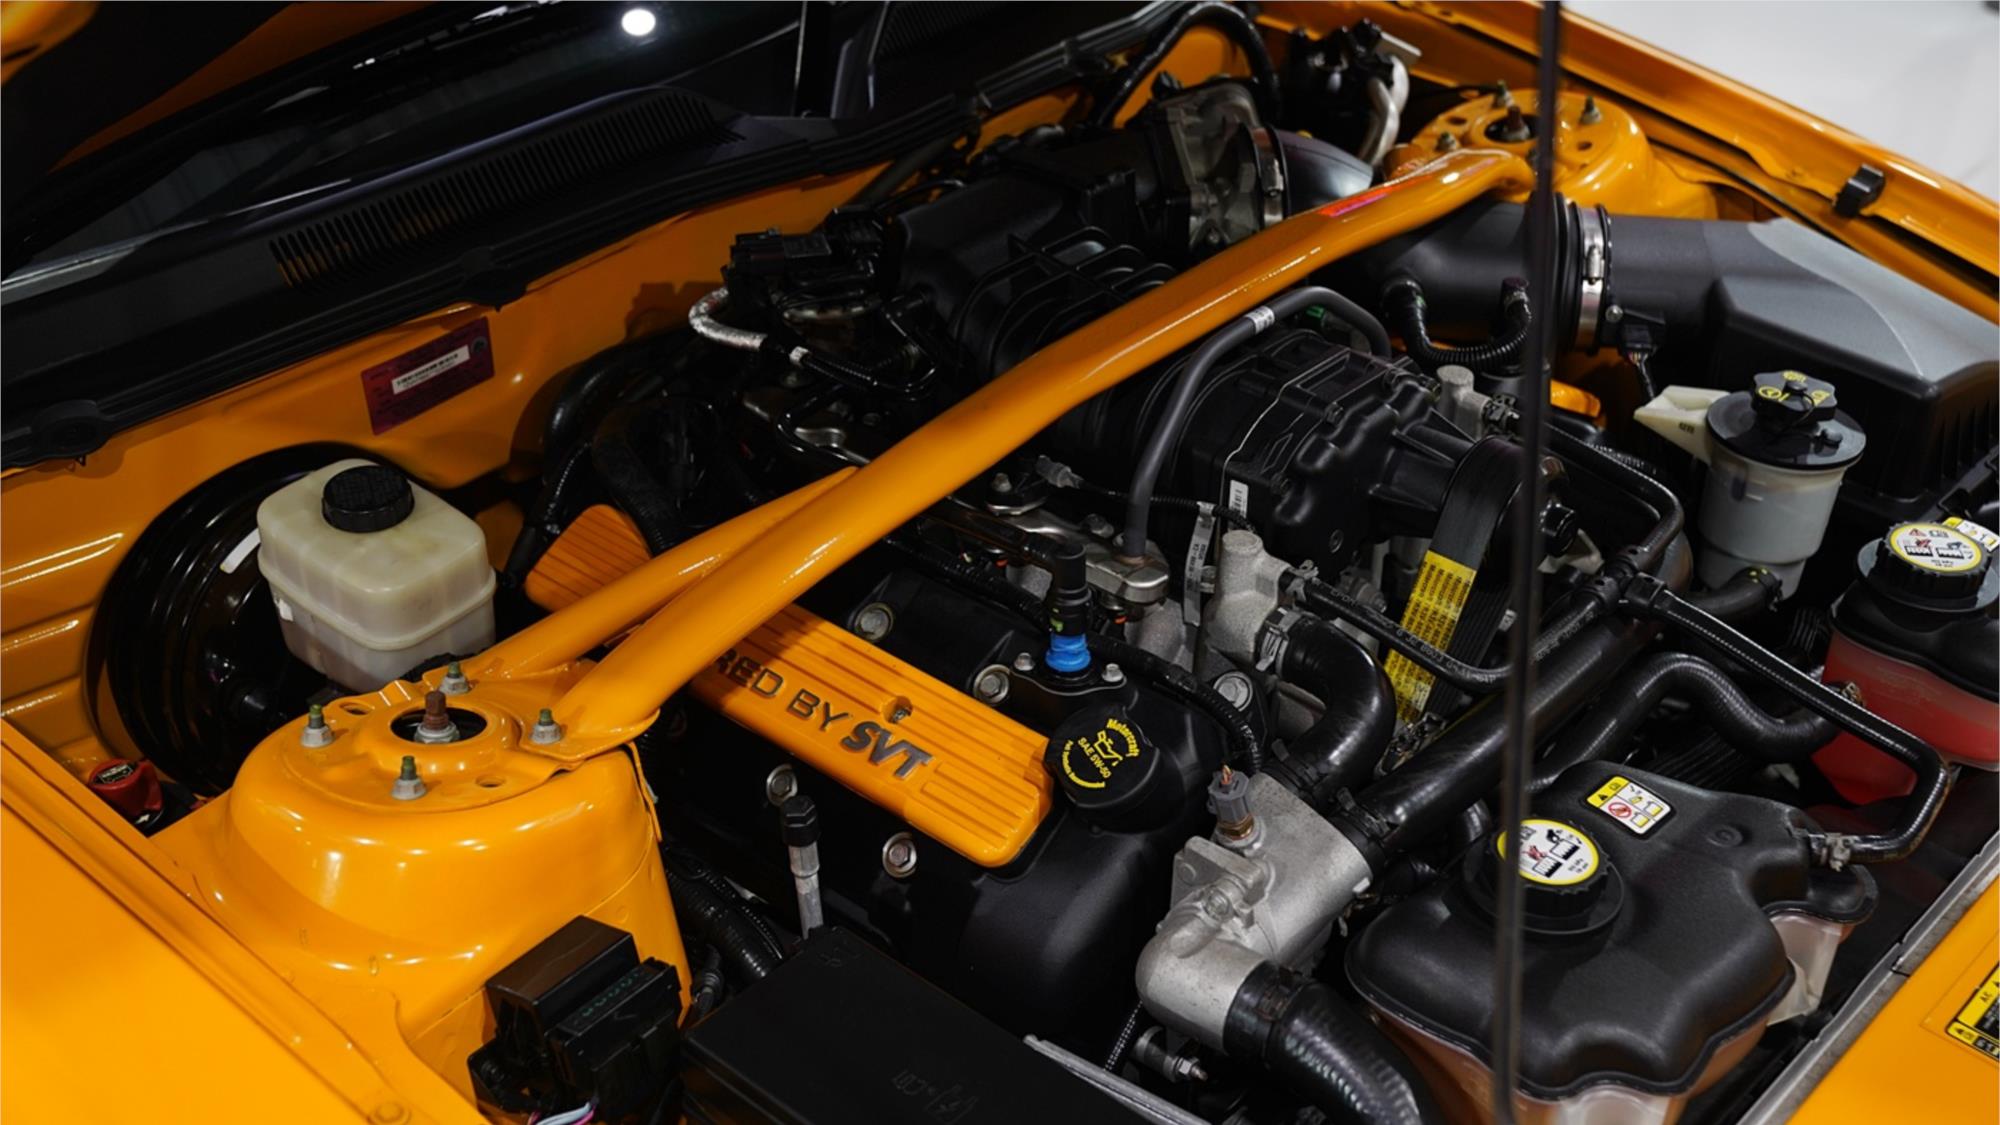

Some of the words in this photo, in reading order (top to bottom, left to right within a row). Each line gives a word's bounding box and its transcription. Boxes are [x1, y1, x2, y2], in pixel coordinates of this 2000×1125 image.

[786, 689, 848, 731] BY
[841, 720, 933, 779] SVT
[1078, 737, 1096, 757] SAE
[1106, 718, 1140, 757] Motorcraft
